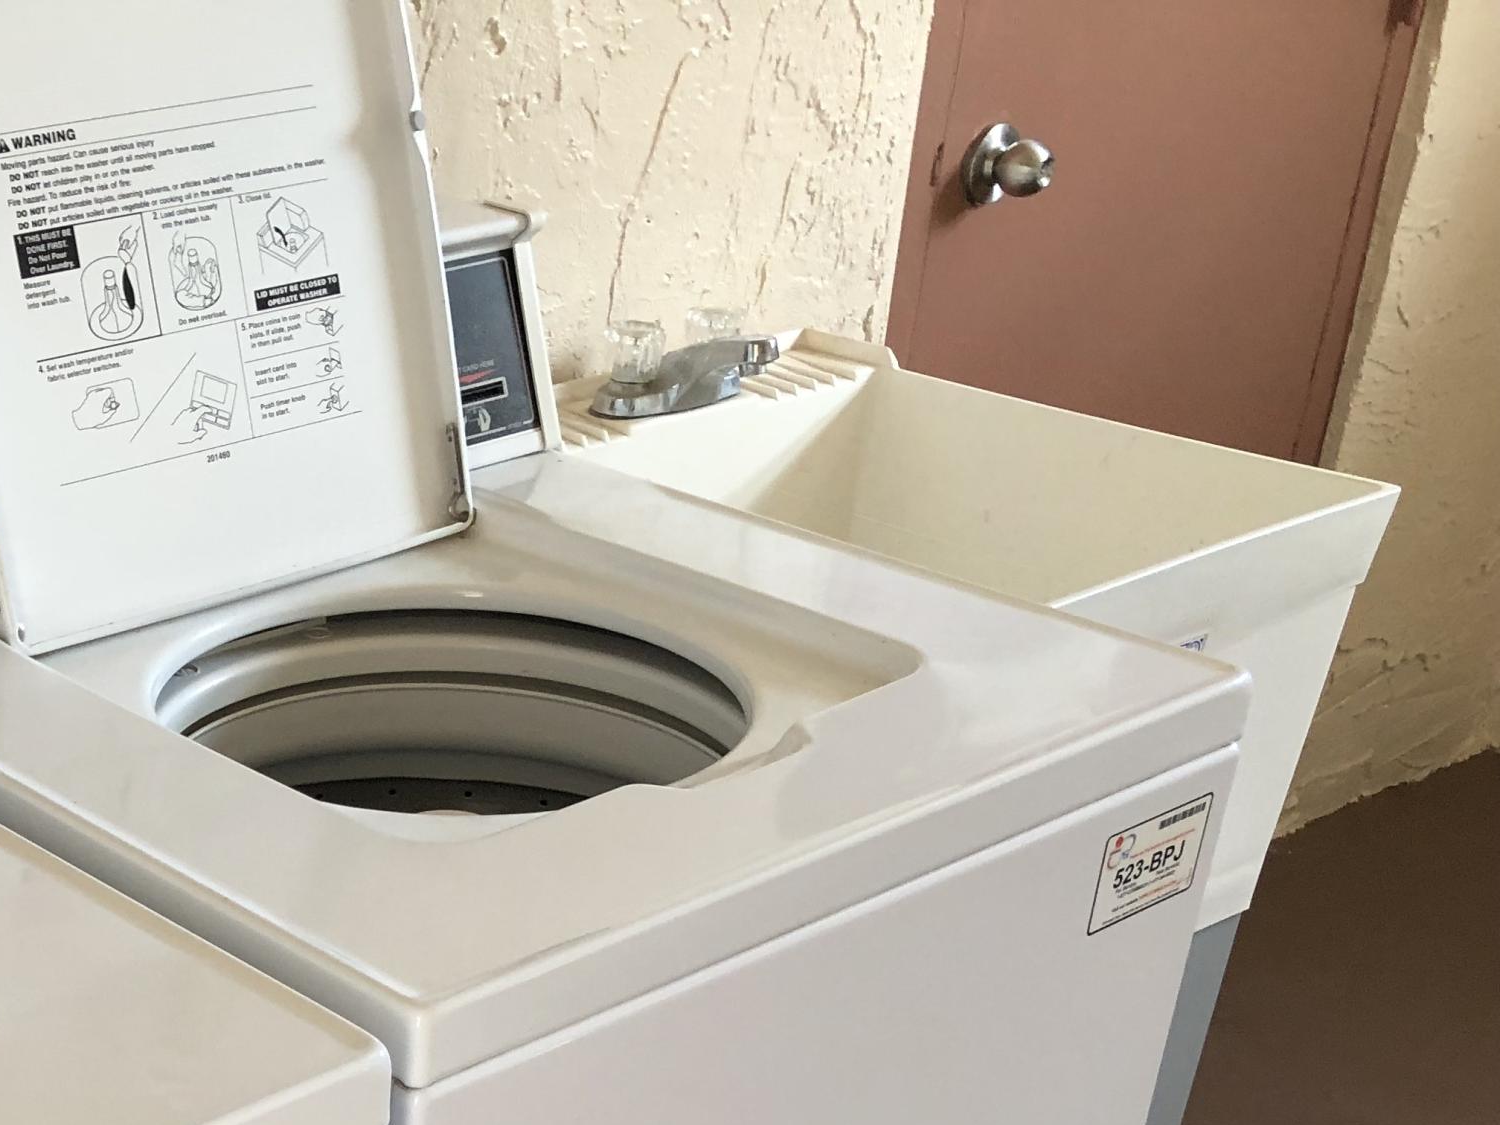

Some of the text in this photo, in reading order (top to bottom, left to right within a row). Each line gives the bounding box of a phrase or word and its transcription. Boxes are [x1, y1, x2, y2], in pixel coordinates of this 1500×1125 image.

[11, 128, 76, 149] WARNING
[22, 169, 38, 179] NOT
[24, 182, 40, 191] NOT
[29, 206, 45, 215] NOT
[31, 218, 47, 227] NOT
[256, 290, 268, 299] LID
[268, 286, 287, 296] MUST
[299, 278, 326, 289] CLOSED
[267, 288, 327, 306] OPERATE WASHER
[1113, 840, 1185, 889] 523-BPJ
